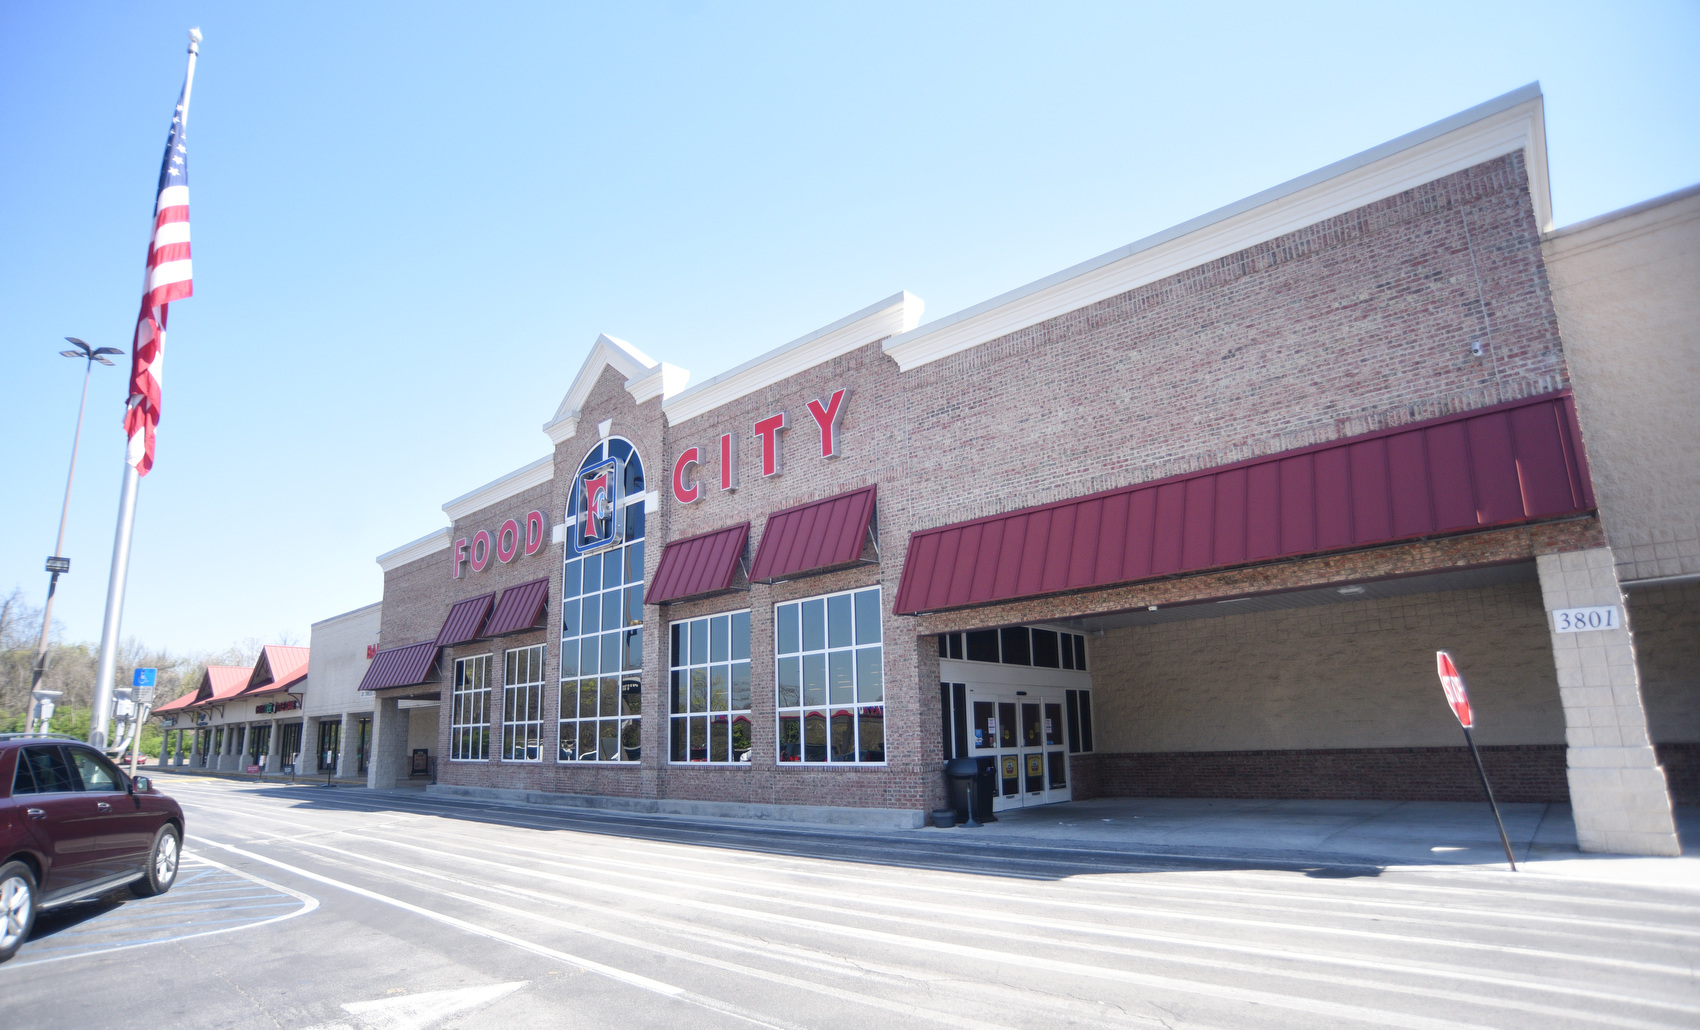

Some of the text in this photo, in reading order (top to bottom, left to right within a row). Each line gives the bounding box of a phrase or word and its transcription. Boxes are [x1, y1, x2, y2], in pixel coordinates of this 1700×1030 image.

[453, 387, 848, 579] FOOD CITY
[1560, 609, 1613, 630] 3801
